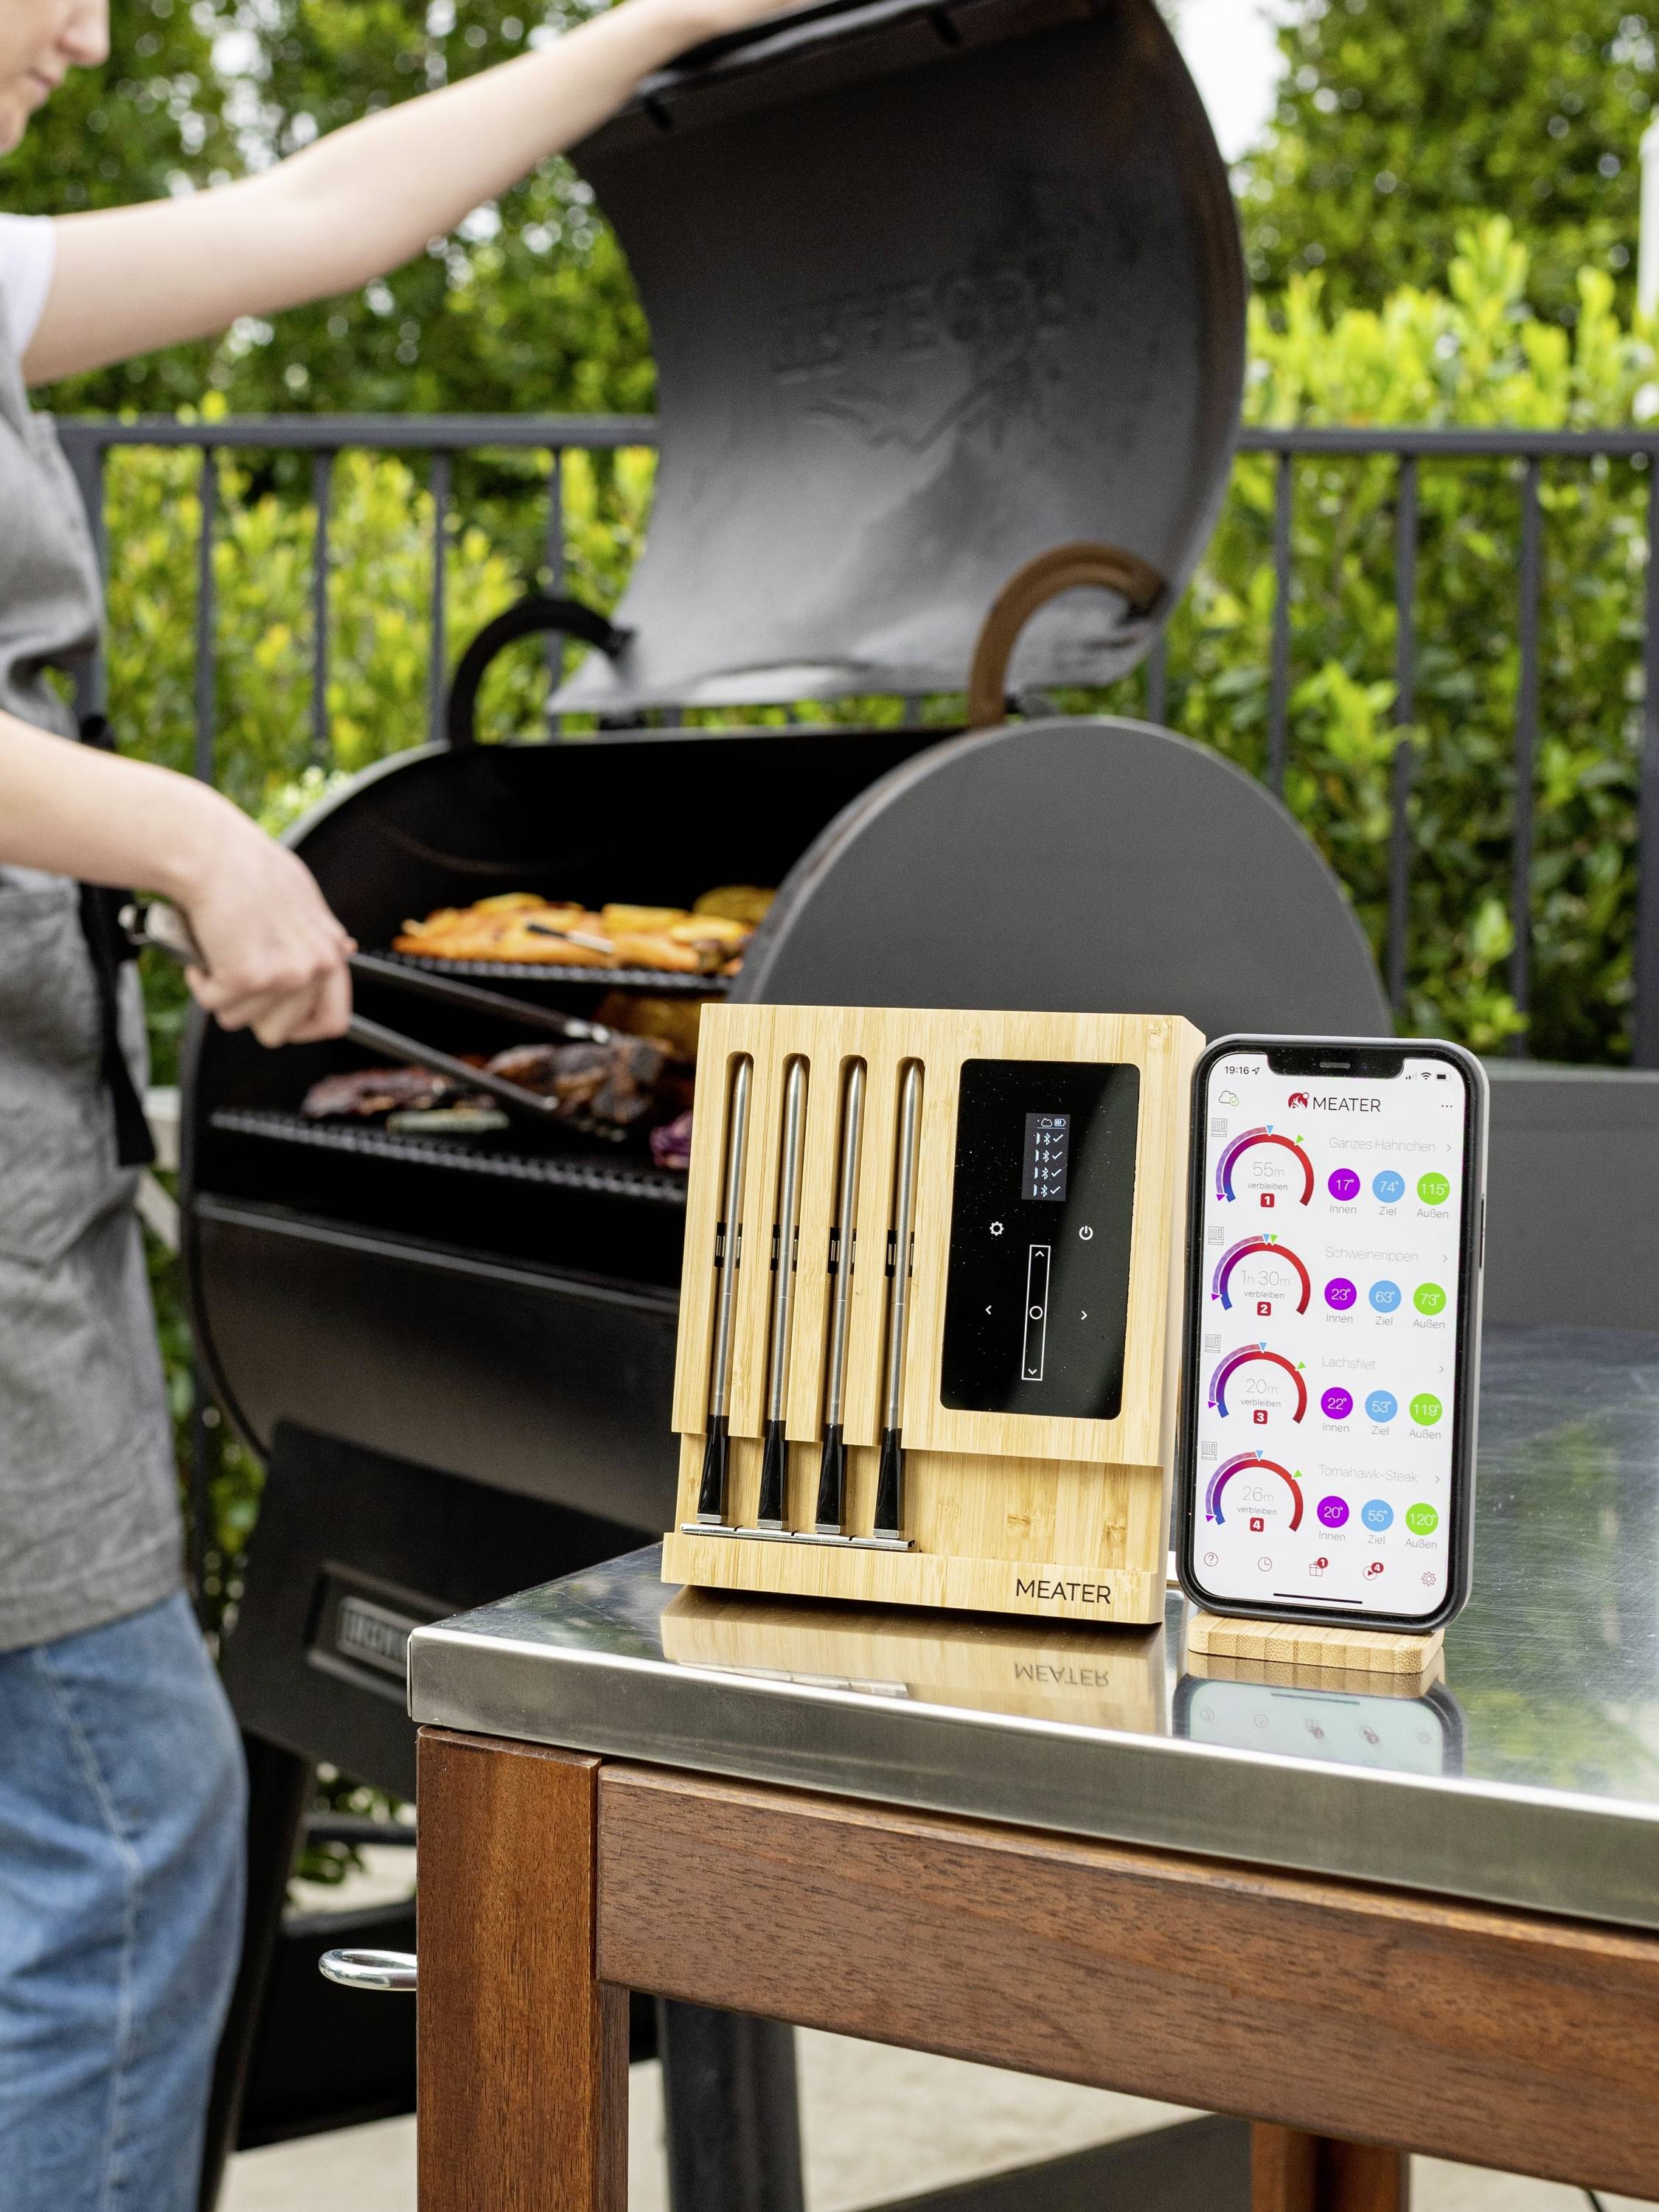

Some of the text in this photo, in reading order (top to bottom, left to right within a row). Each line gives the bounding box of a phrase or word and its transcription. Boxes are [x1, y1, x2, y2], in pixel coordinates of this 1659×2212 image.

[1224, 1065, 1249, 1075] 19:16
[1312, 1096, 1380, 1113] MEATER
[1329, 1137, 1436, 1152] Ganzes Hähnchen
[1248, 1182, 1288, 1191] verbleiben
[1330, 1205, 1357, 1215] Innen
[1379, 1206, 1397, 1217] Ziel
[1416, 1208, 1449, 1220] Außen
[1326, 1247, 1418, 1263] Schweinerippen
[1244, 1290, 1284, 1299] verbleiben
[1326, 1314, 1353, 1324] Innen
[1375, 1316, 1393, 1326] Ziel
[1413, 1318, 1445, 1329] Außen
[1322, 1356, 1376, 1371] Lachsfilet
[1241, 1398, 1281, 1408] verbleiben
[1323, 1423, 1349, 1434] Innen
[1371, 1425, 1389, 1436] Ziel
[1409, 1429, 1441, 1440] Außen
[1319, 1464, 1418, 1483] Tomahawk-Steak
[1237, 1506, 1277, 1515] verbleiben
[1318, 1531, 1345, 1542] Innen
[1368, 1534, 1385, 1545] Ziel
[1405, 1539, 1437, 1550] Außen
[1016, 1579, 1111, 1604] MEATER
